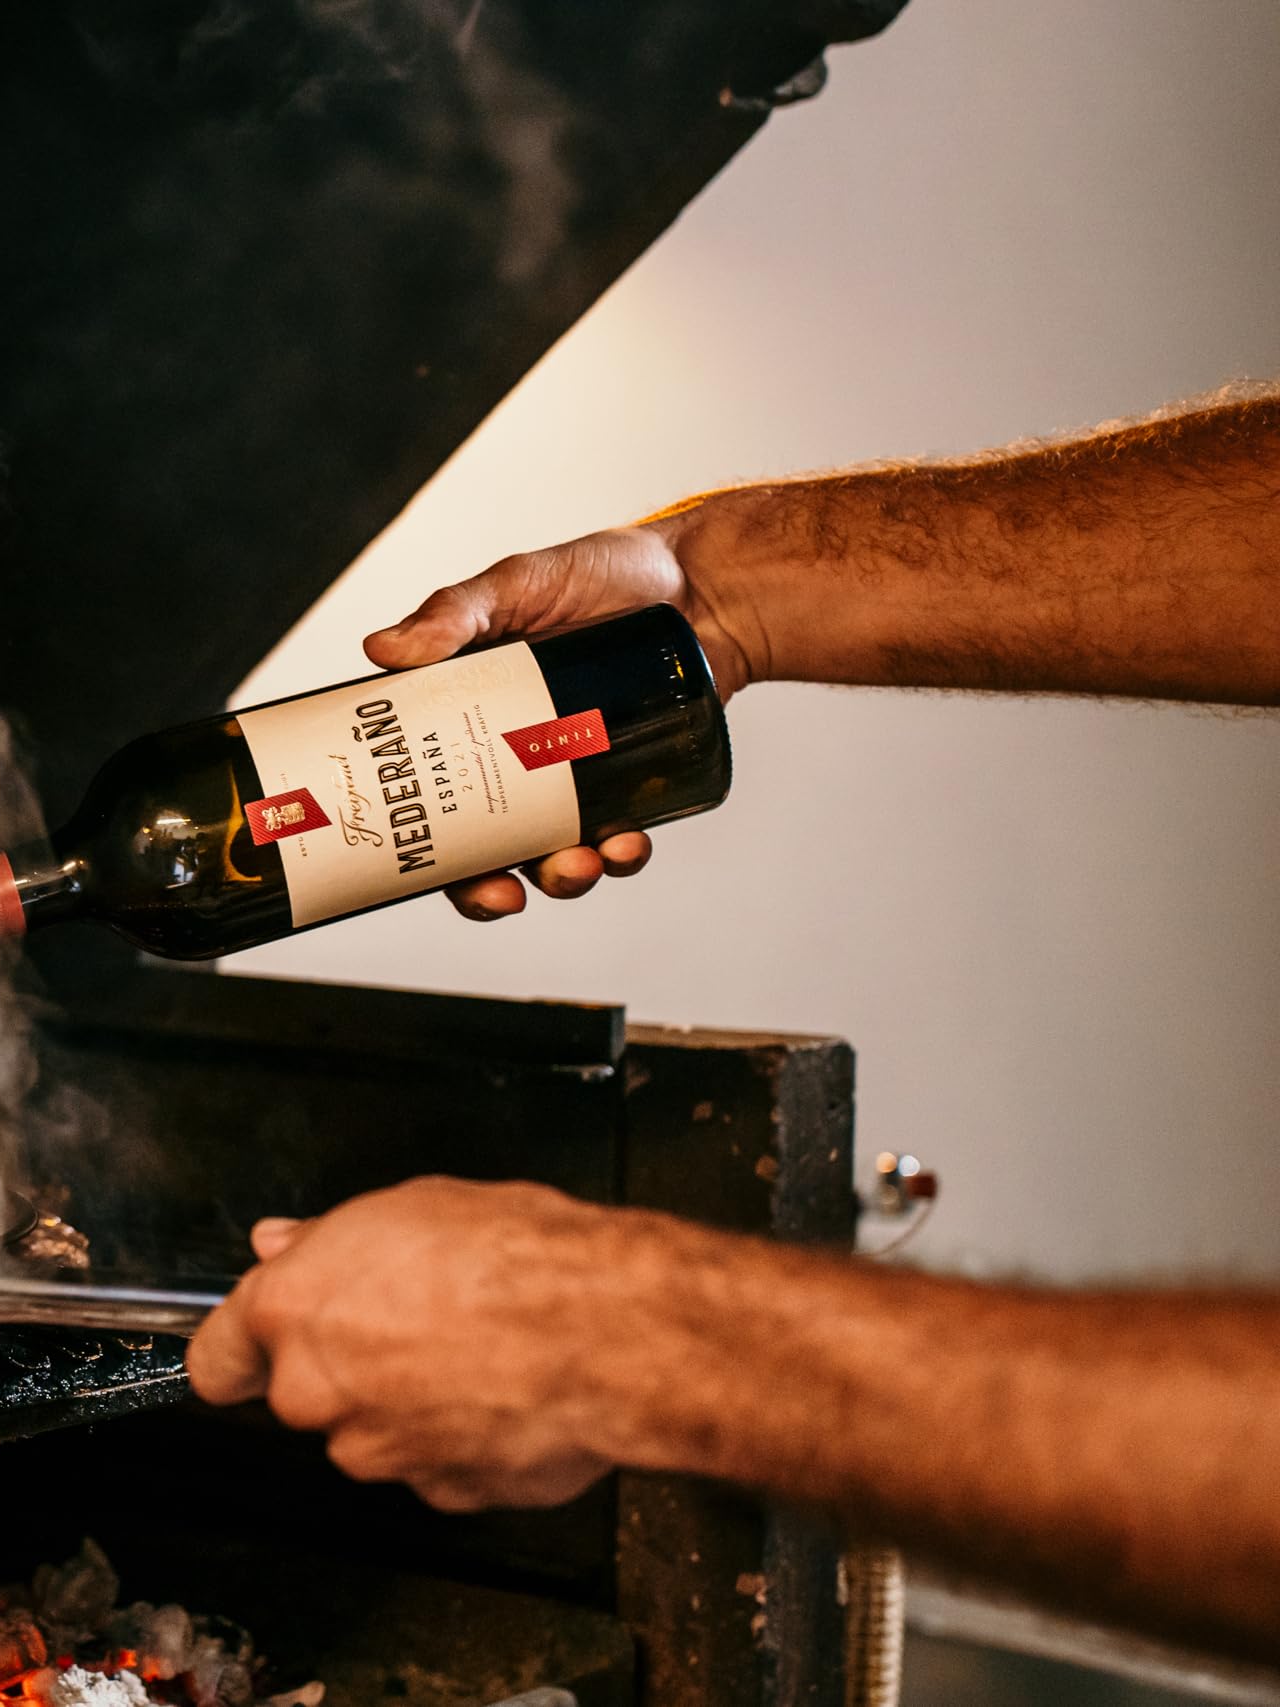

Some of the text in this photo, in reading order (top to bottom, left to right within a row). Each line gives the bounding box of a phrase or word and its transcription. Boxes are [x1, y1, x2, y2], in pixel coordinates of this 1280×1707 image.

[422, 732, 458, 814] ESPAÑA
[450, 742, 473, 792] 2021
[486, 738, 508, 813] TEMPERAMENTVOLL
[529, 727, 593, 753] TINTO
[352, 699, 436, 874] MEDERAÑO
